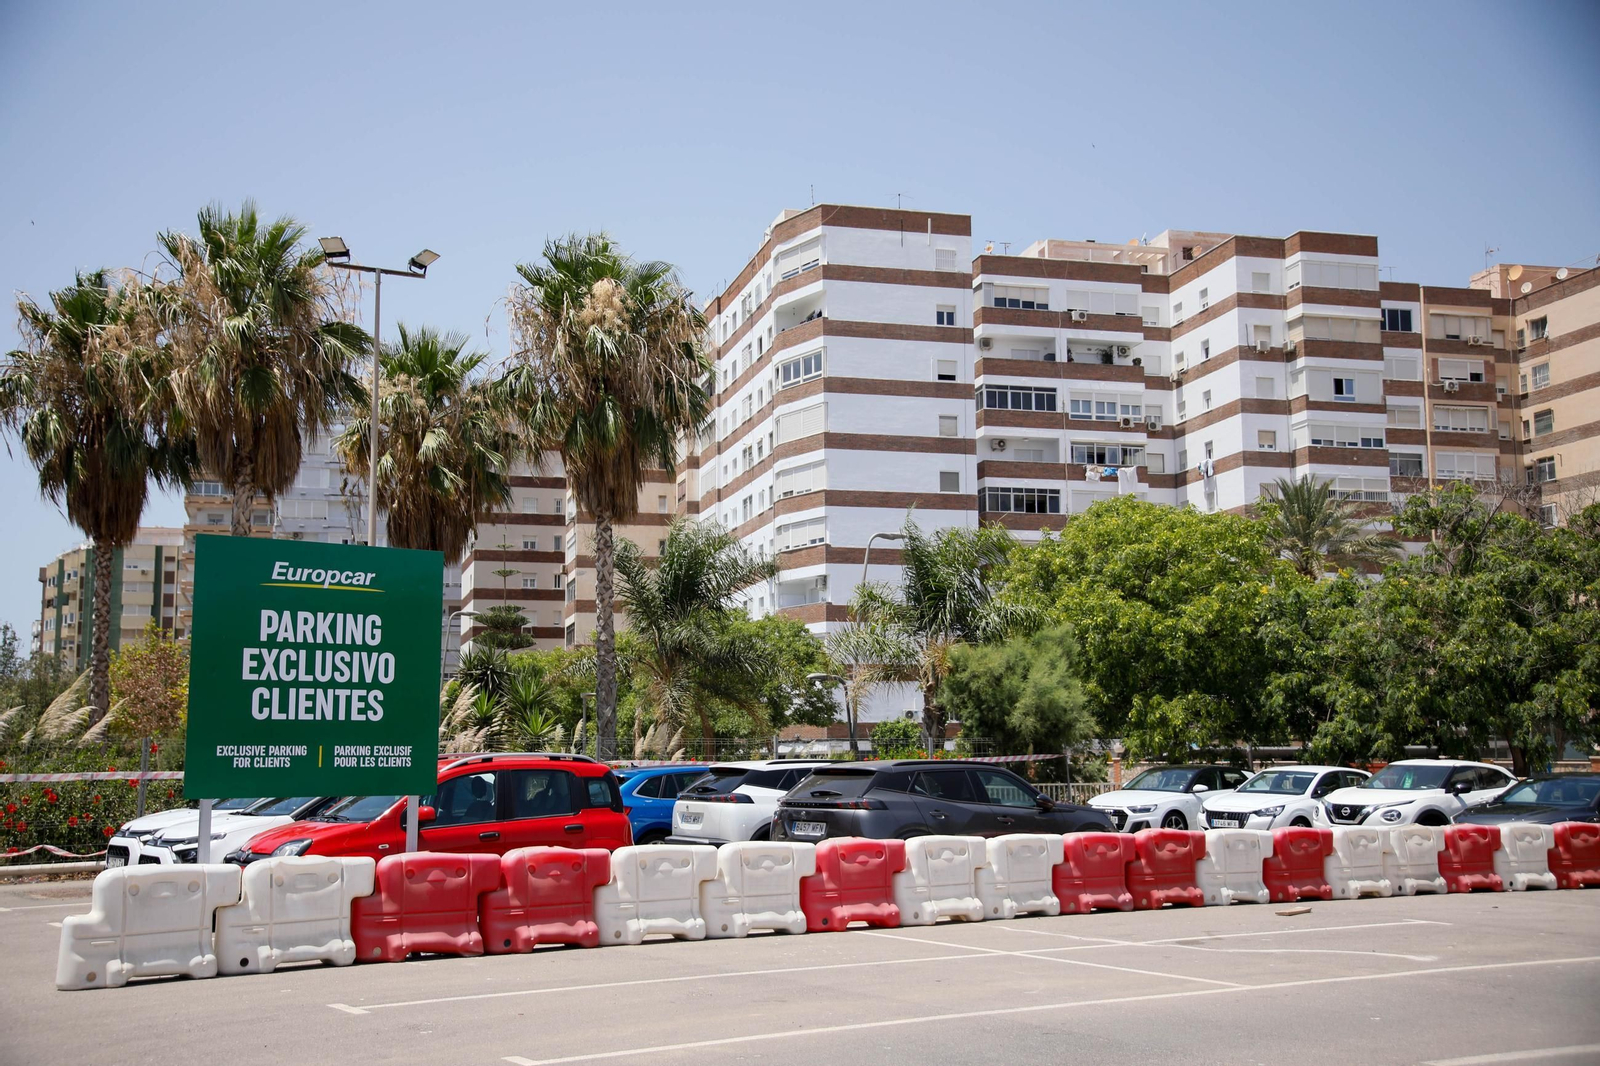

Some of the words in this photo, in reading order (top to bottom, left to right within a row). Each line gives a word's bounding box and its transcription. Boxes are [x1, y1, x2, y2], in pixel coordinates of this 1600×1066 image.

[271, 561, 376, 589] Europcar
[259, 609, 382, 646] PARKING
[242, 647, 396, 684] EXCLUSIVO
[251, 686, 384, 722] CLIENTES
[216, 745, 266, 757] EXCLUSIVE
[268, 745, 308, 757] PARKING
[334, 745, 371, 757] PARKING
[373, 745, 413, 757] EXCLUSIF
[233, 756, 251, 768] FOR
[253, 756, 291, 768] CLIENTS
[334, 756, 358, 768] POUR
[359, 756, 376, 768] LES
[377, 756, 412, 768] CLIENTS
[796, 821, 811, 832] 6457
